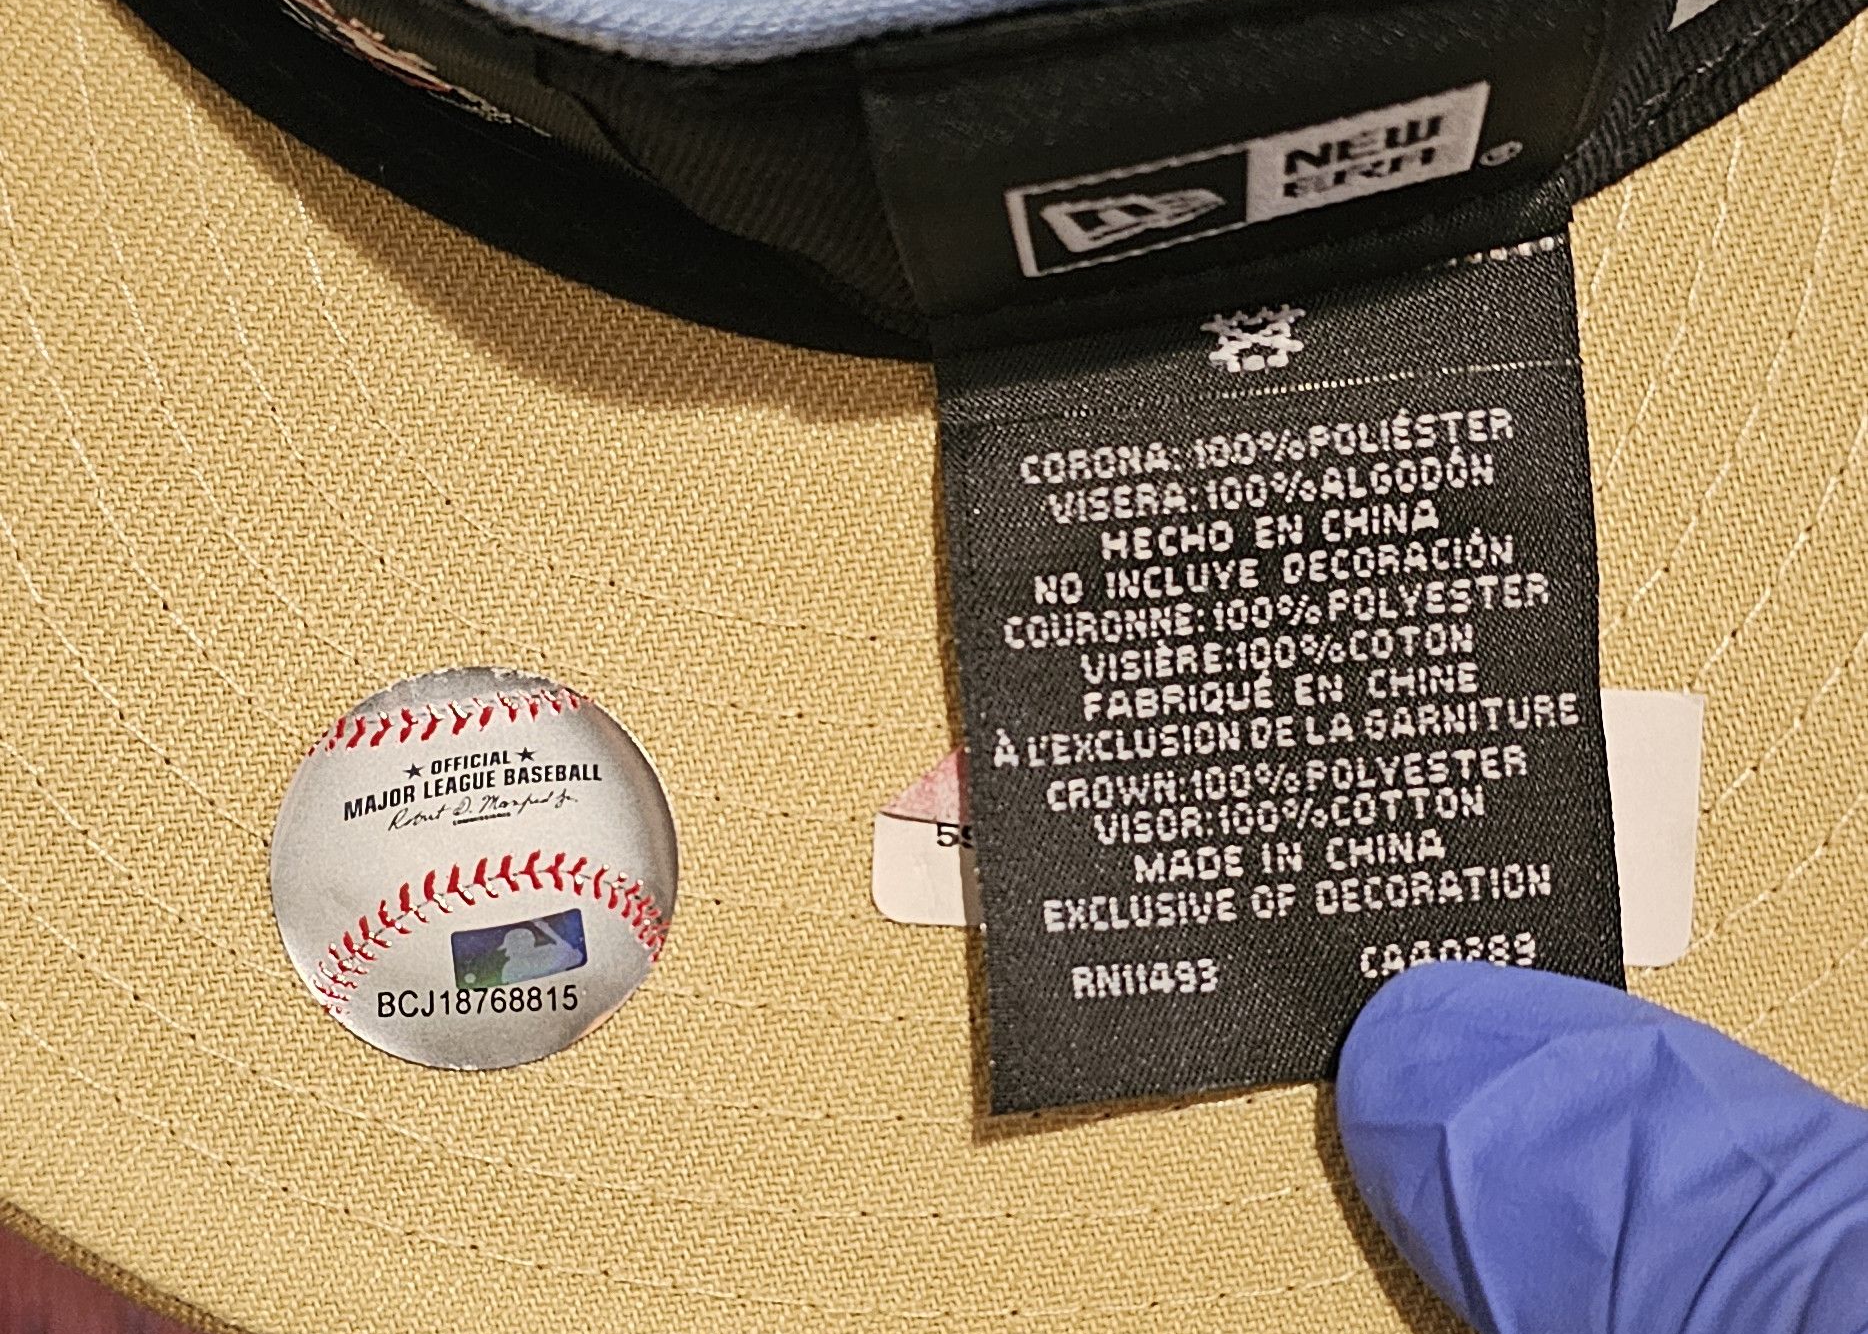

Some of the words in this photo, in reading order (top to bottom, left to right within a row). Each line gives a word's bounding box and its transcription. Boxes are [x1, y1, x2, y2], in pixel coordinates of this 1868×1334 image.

[1283, 115, 1445, 175] NEW
[1101, 520, 1234, 560] HECHO
[1255, 515, 1304, 549] EN
[1322, 499, 1440, 543] CHINA
[1034, 572, 1083, 605] NO
[1105, 558, 1259, 599] INCLUYE
[1283, 527, 1514, 584] DECORACIÓN
[1083, 669, 1274, 721] FABRIQUÉ
[1294, 673, 1343, 706] EN
[1367, 662, 1478, 699] CHINE
[994, 728, 1019, 767] À
[1250, 716, 1296, 749] DE
[1305, 712, 1353, 746] LA
[1364, 692, 1579, 741] GARNITURE
[343, 784, 416, 821] MAJOR
[423, 770, 496, 798] LEAGUE
[503, 763, 603, 786] BASEBALL
[430, 750, 511, 775] OFFICIAL
[1134, 845, 1244, 883] MADE
[1261, 842, 1302, 873] IN
[1326, 828, 1446, 871] CHINA
[1043, 887, 1238, 932] EXCLUSIVE
[1251, 883, 1296, 919] OF
[1315, 863, 1551, 915] DECORATION
[377, 984, 579, 1018] BCJ18768815
[1071, 957, 1219, 1000] RN11493
